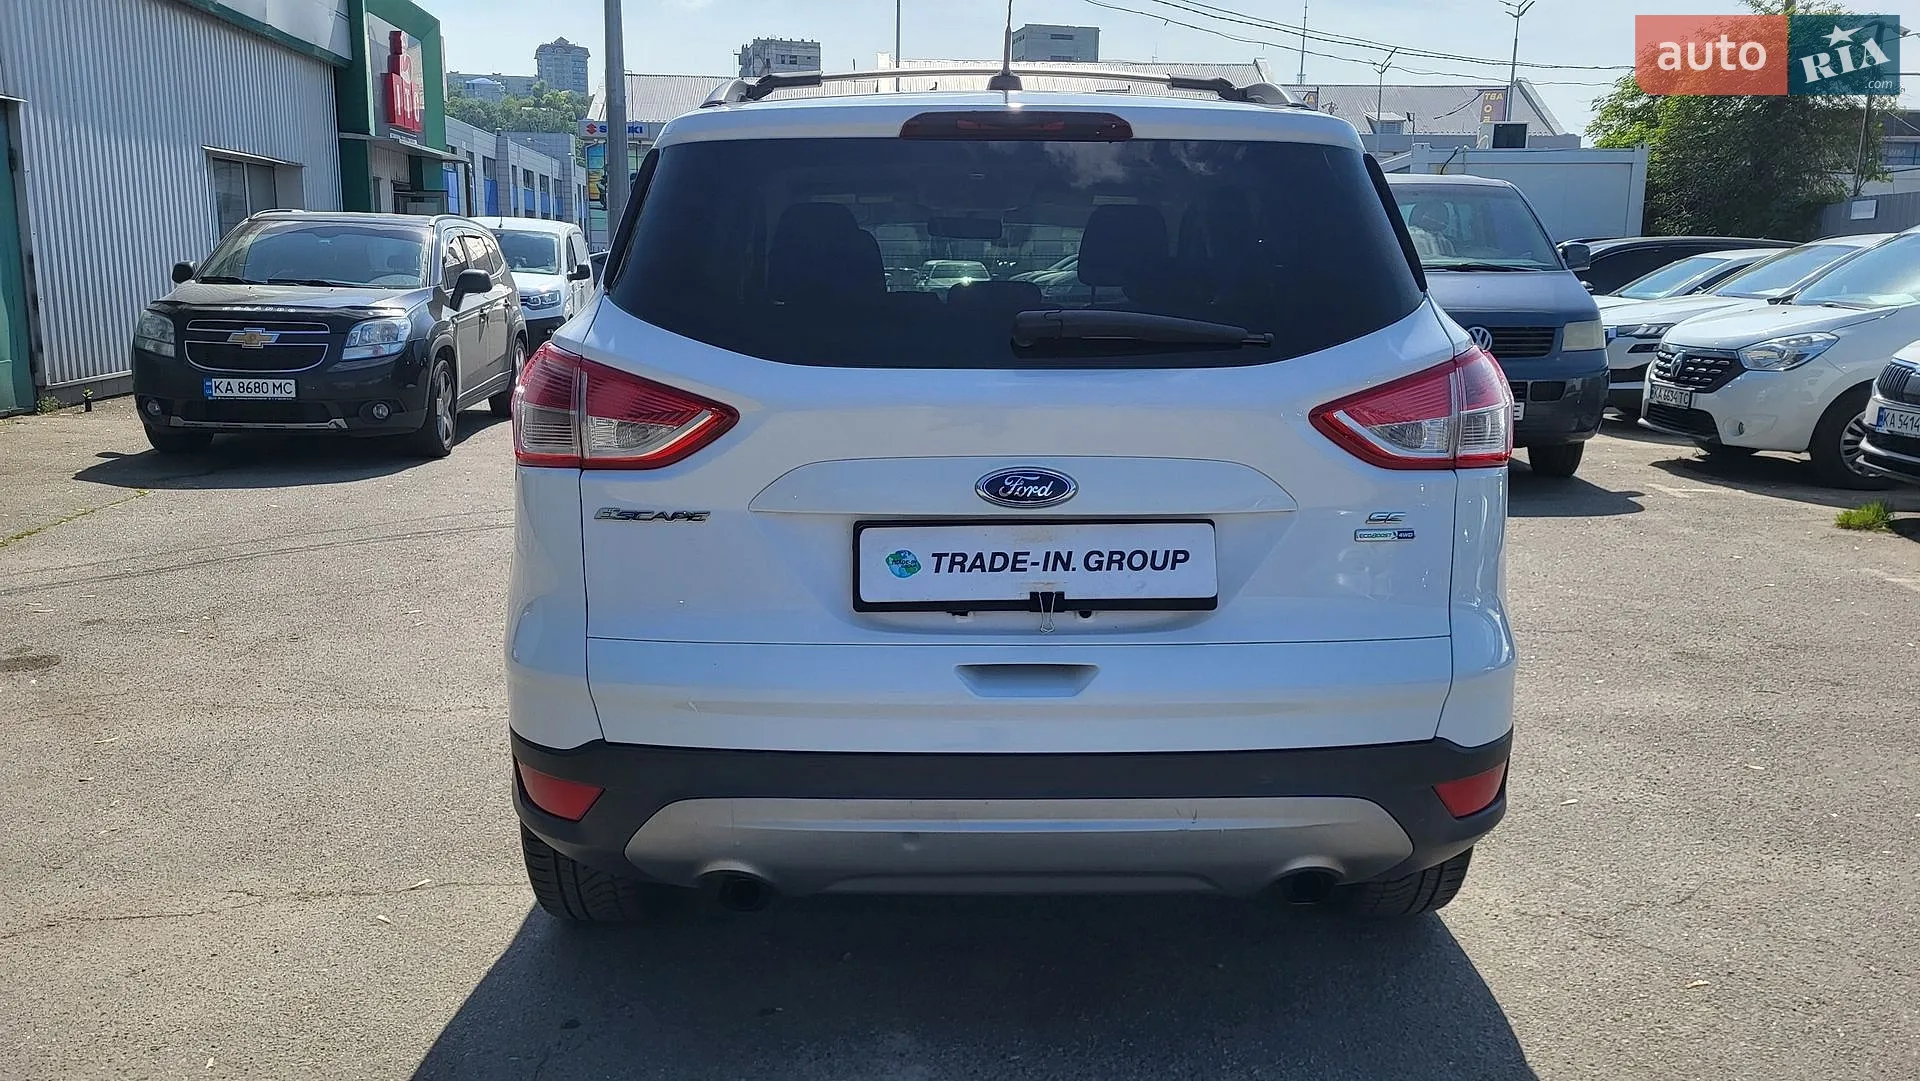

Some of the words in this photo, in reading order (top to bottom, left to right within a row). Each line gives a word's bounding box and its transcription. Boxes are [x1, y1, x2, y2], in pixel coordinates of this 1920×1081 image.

[214, 381, 234, 394] KA
[238, 381, 269, 394] 8680
[273, 382, 293, 394] MC
[1884, 412, 1896, 428] KA
[998, 475, 1054, 497] Ford
[1083, 549, 1190, 572] GROUP
